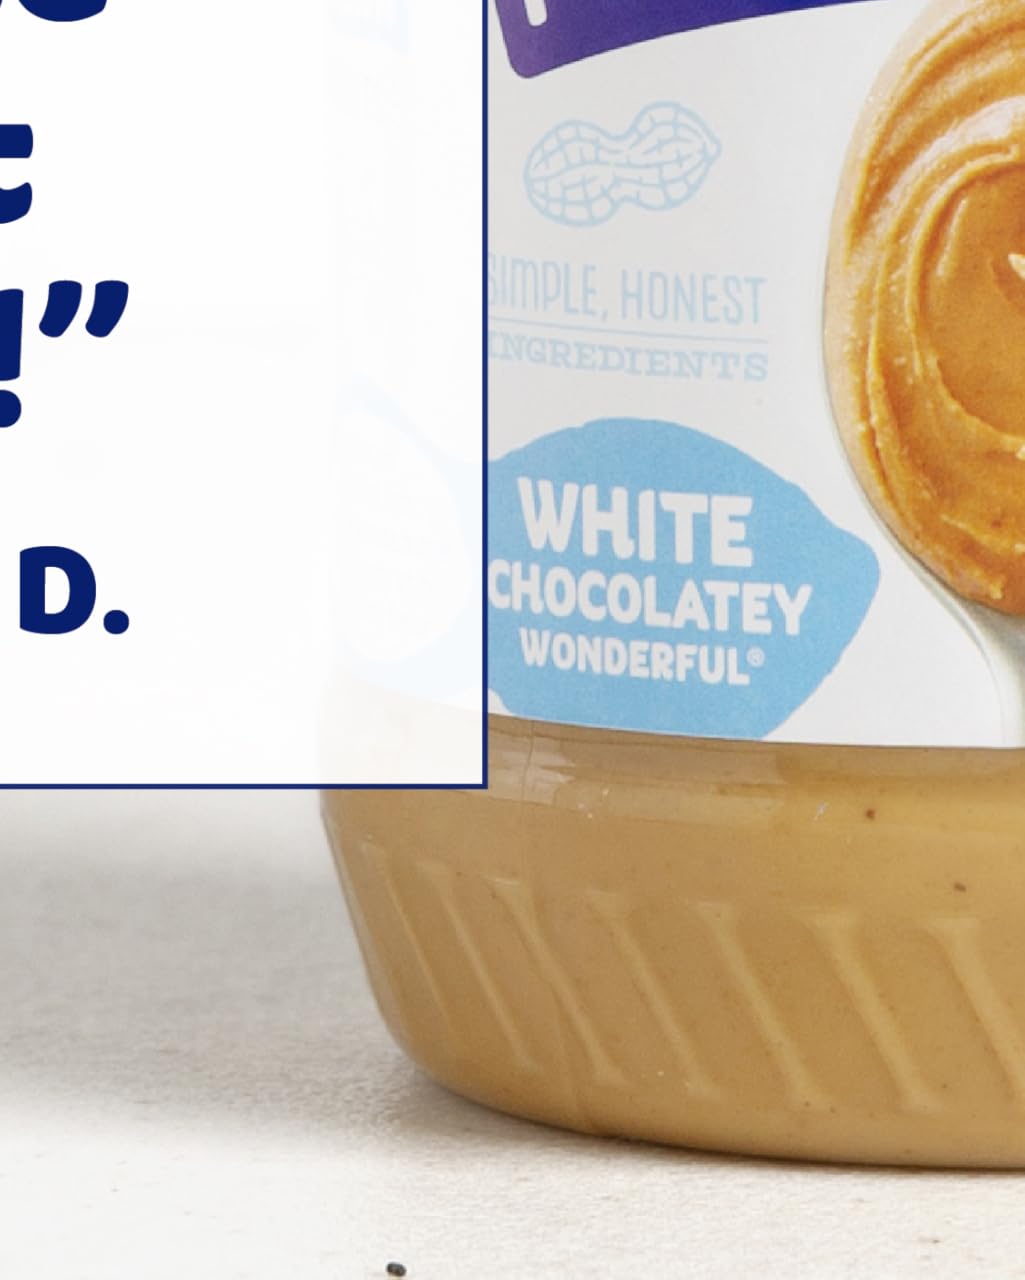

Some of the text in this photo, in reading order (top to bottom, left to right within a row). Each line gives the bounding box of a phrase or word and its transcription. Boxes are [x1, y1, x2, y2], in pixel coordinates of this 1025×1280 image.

[621, 269, 769, 326] HONEST
[517, 476, 753, 568] WHITE
[487, 559, 812, 635] CHOCOLATEY
